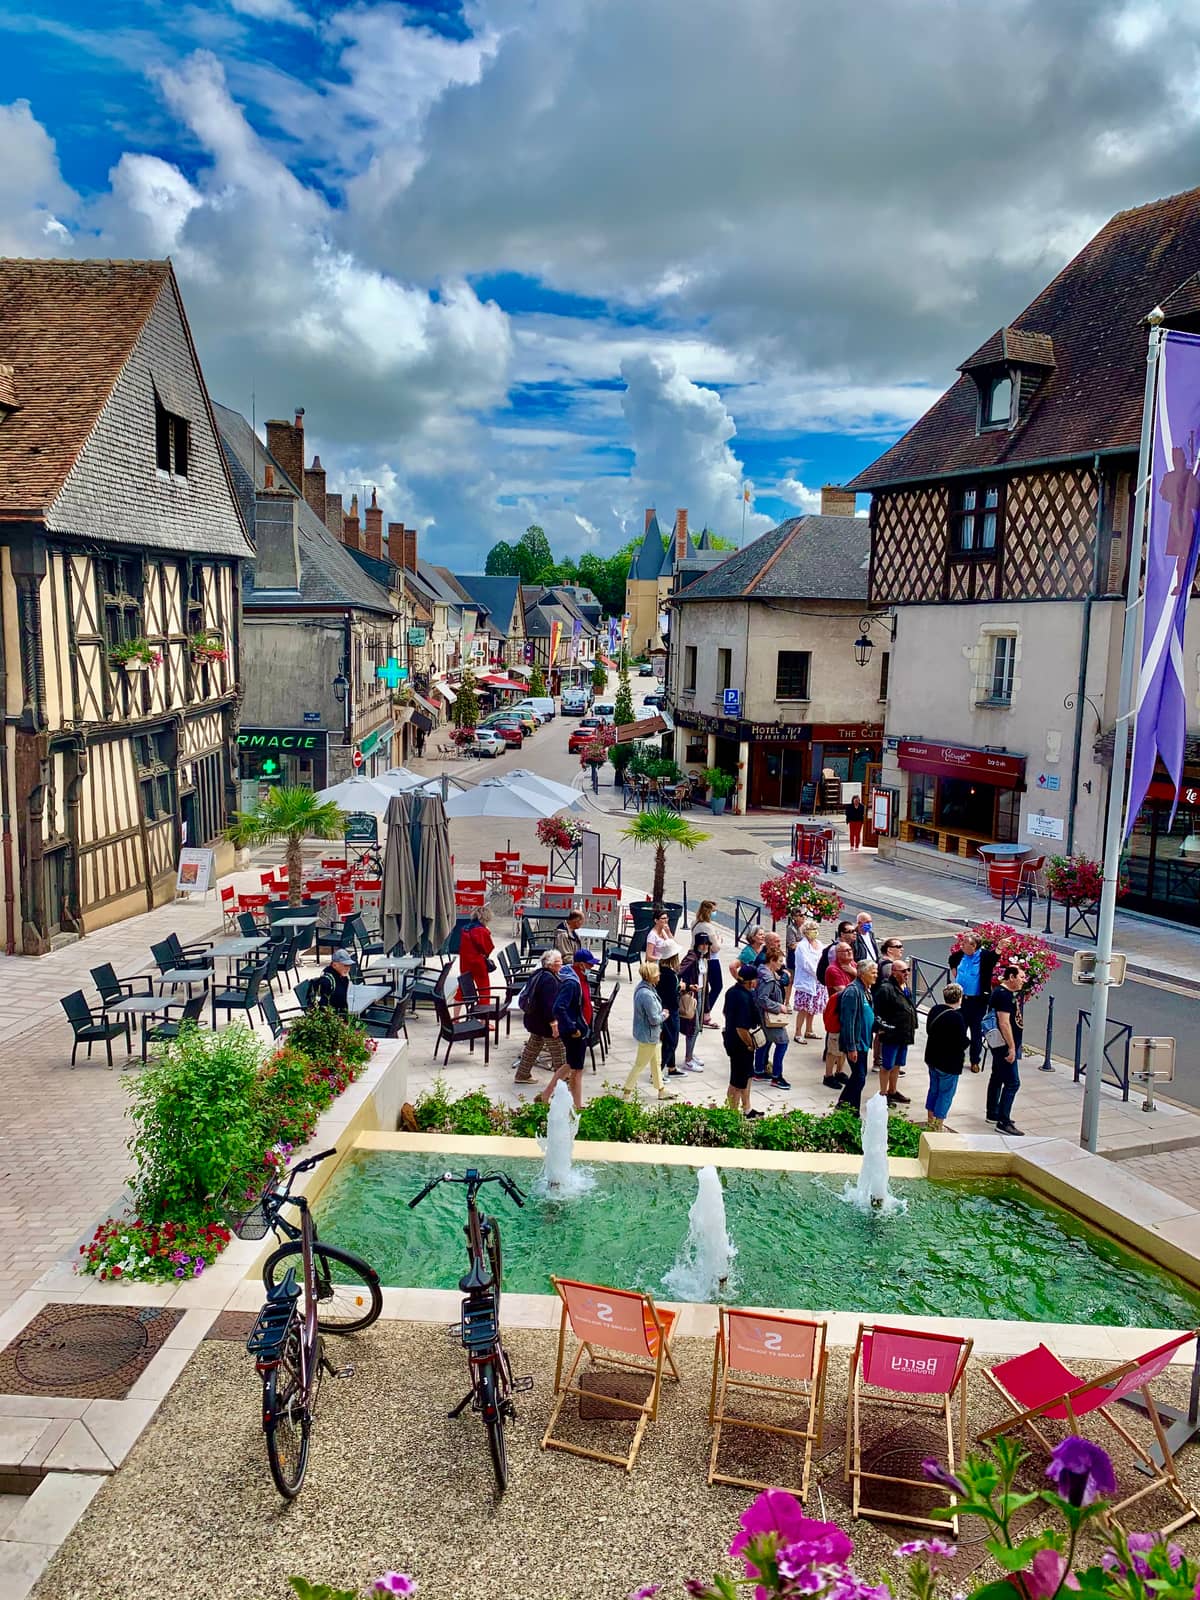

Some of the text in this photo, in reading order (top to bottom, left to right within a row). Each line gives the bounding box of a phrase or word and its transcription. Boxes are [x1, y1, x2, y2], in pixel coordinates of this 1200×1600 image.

[728, 691, 736, 702] P
[751, 725, 780, 735] HOTEL
[838, 729, 857, 738] THE
[236, 735, 318, 749] RMACIE
[1185, 788, 1198, 804] Le
